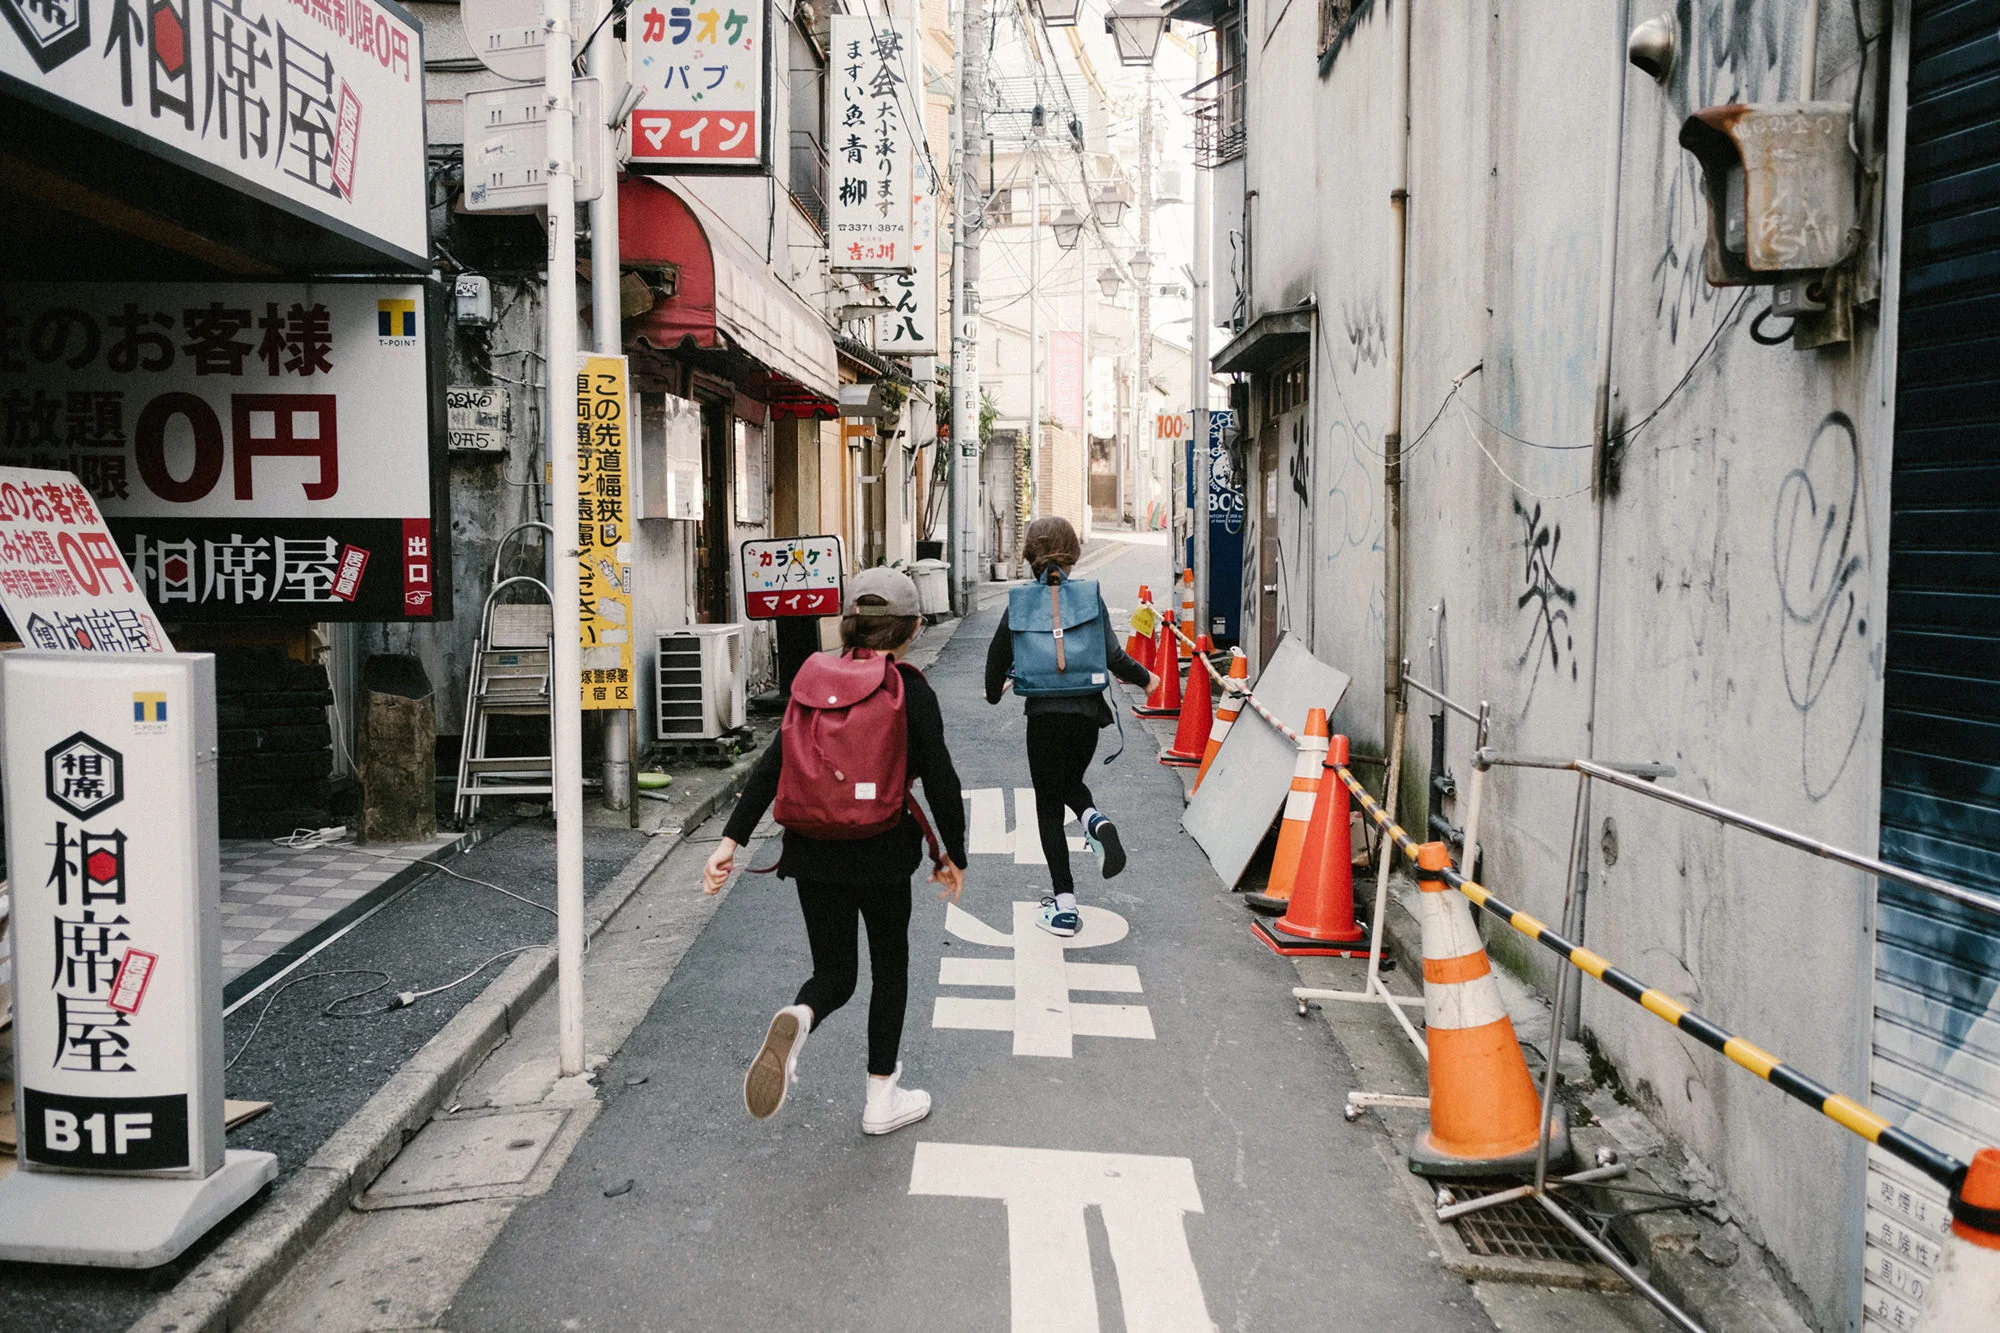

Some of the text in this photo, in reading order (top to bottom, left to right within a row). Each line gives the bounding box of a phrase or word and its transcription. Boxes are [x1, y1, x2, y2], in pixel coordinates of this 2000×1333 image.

[642, 7, 749, 46] カラオケ
[103, 0, 343, 199] 相席屋
[664, 65, 729, 90] パブ
[640, 117, 749, 151] マイン
[868, 28, 905, 218] 宴会大小承ります
[847, 242, 896, 262] 吉乃川
[378, 339, 417, 347] T-POINT
[134, 390, 340, 504] 0円
[594, 373, 623, 548] この先道幅狭し
[57, 531, 134, 597] 0円
[124, 533, 344, 605] 相席屋
[408, 536, 428, 583] 出口
[759, 548, 821, 568] カラオケ
[762, 594, 824, 610] マイン
[60, 753, 105, 799] 相席
[44, 821, 137, 1072] 相席屋
[44, 1108, 152, 1155] B1F
